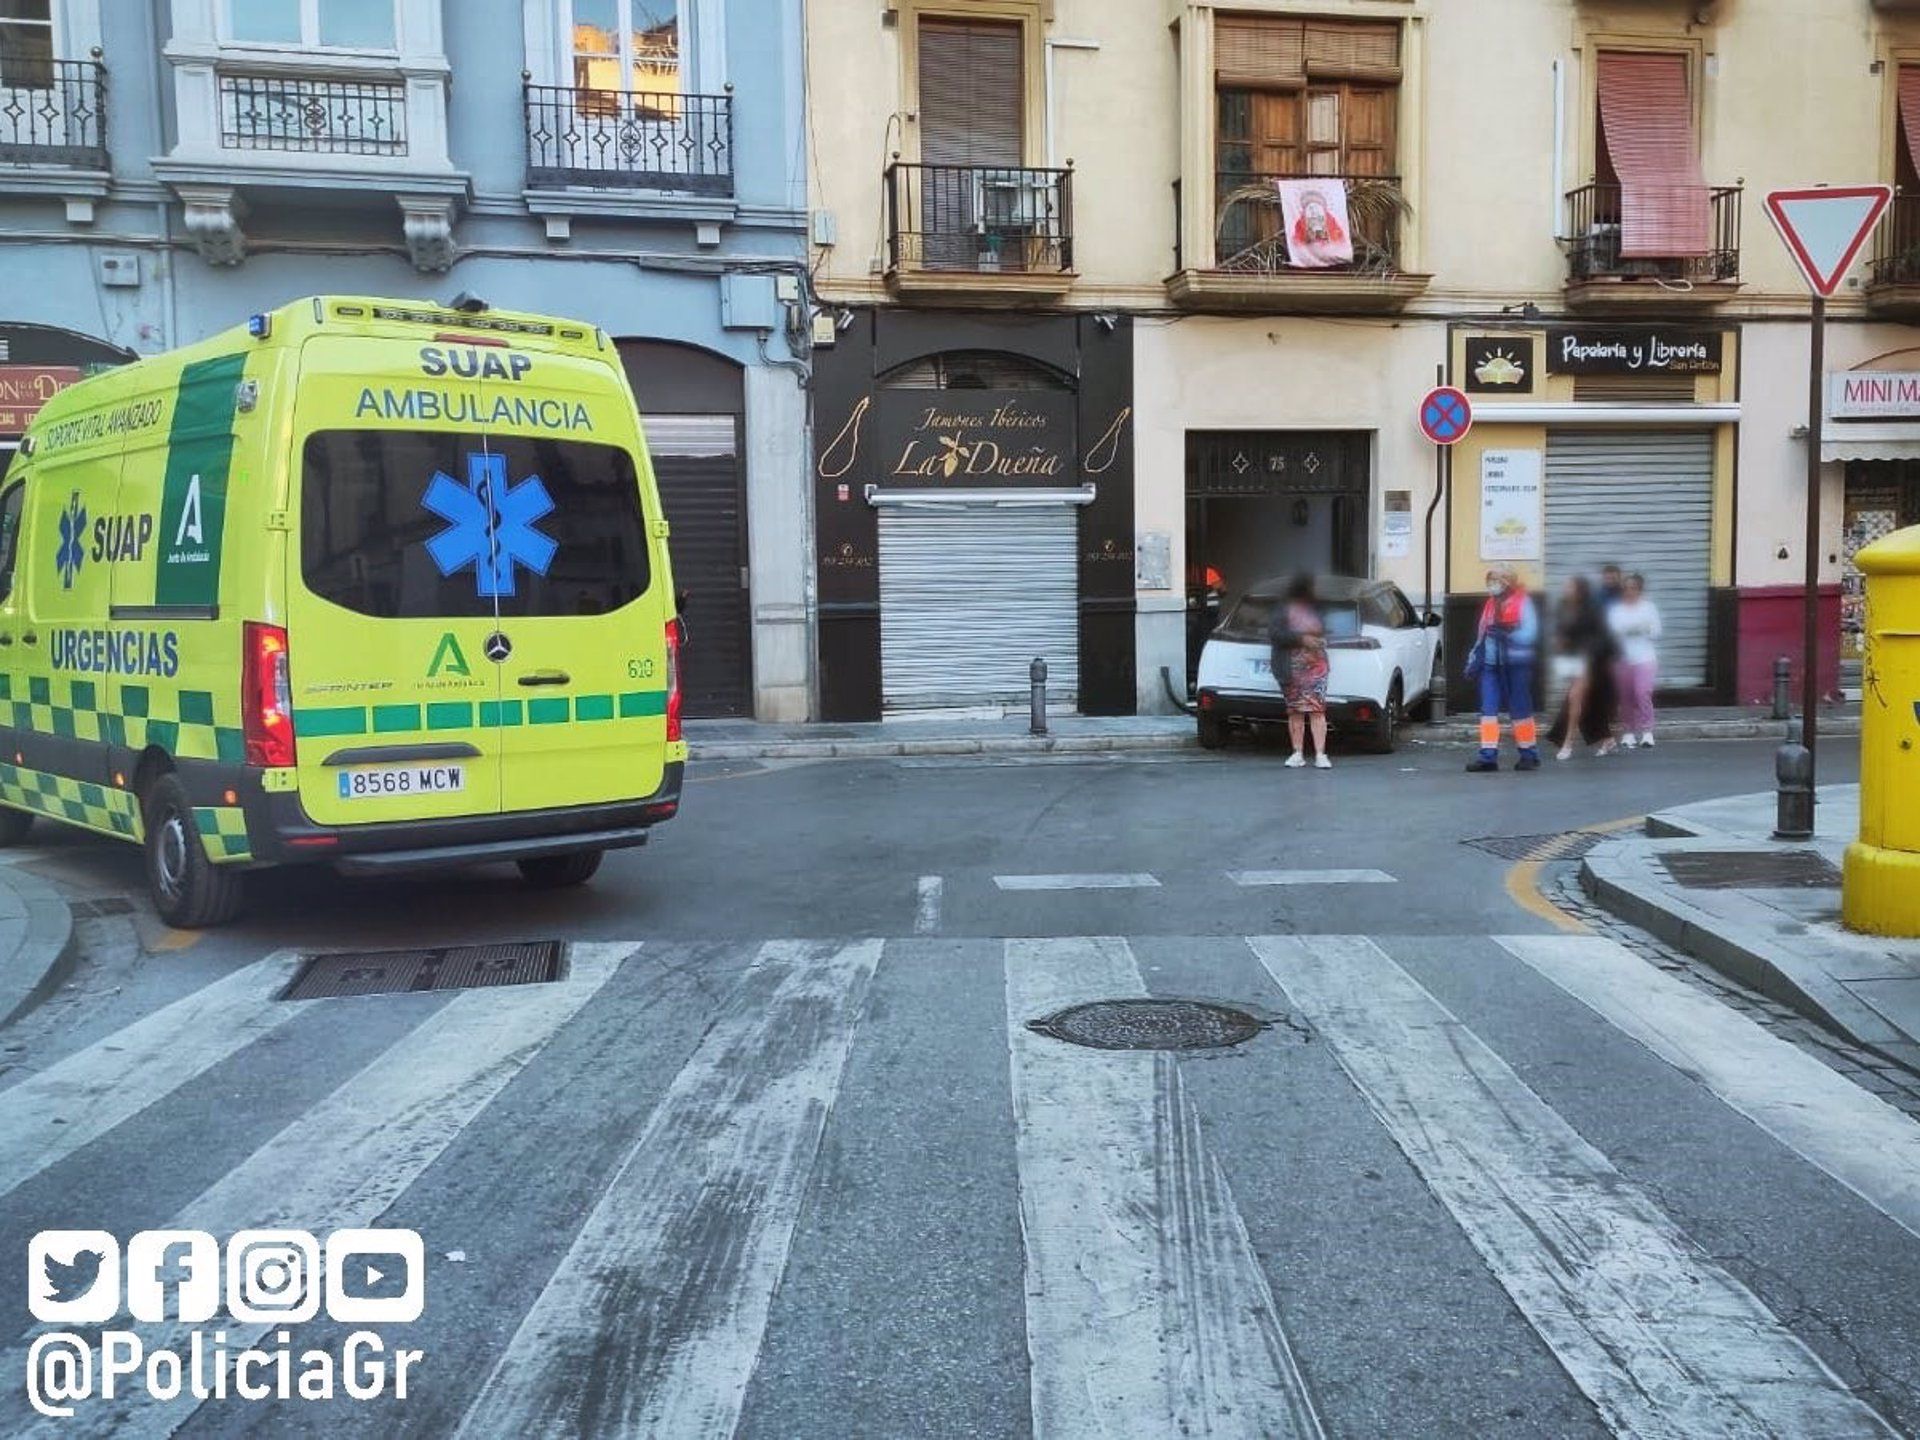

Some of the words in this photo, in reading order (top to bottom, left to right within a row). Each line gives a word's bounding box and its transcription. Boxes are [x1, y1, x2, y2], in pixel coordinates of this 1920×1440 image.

[421, 347, 532, 381] SUAP
[1562, 335, 1627, 362] Papelería
[1627, 345, 1643, 368] y
[1648, 335, 1707, 367] Librería
[1844, 379, 1892, 402] MINI
[1897, 379, 1920, 402] M
[106, 399, 162, 434] AVANZADO
[355, 388, 593, 431] AMBULANCIA
[913, 407, 983, 430] Jamones
[893, 440, 941, 476] La
[965, 440, 1064, 476] Dueña
[1269, 456, 1285, 471] 75
[92, 513, 153, 563] SUAP
[50, 628, 179, 679] URGENCIAS
[628, 659, 653, 679] 610
[353, 771, 410, 795] 8568
[419, 767, 461, 790] MCW
